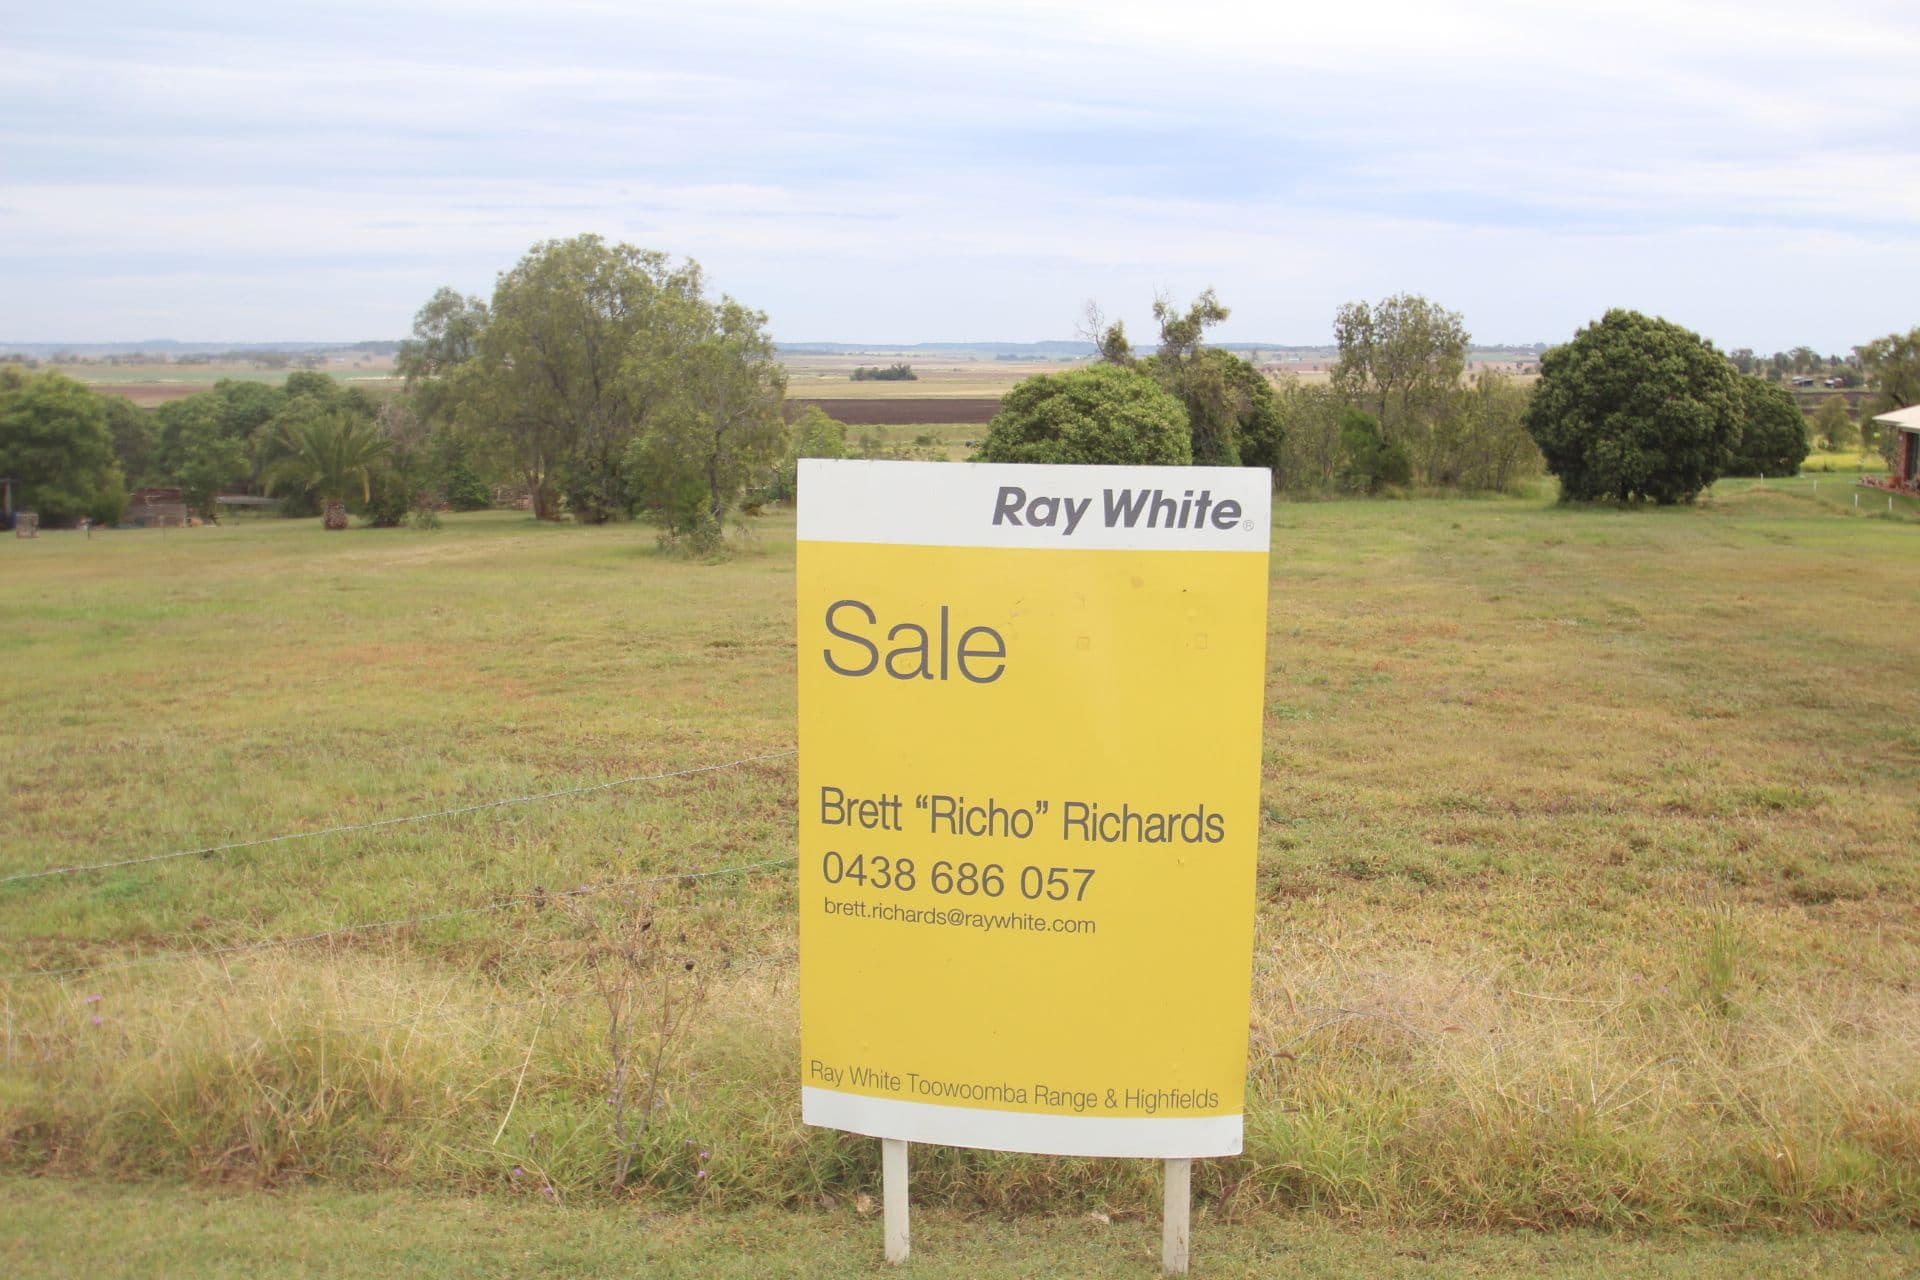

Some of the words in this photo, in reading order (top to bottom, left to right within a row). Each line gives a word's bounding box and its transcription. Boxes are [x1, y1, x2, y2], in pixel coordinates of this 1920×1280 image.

[992, 486, 1092, 536] Ray
[823, 599, 1007, 684] Sale
[821, 786, 903, 831] Brett
[1063, 801, 1225, 844] Richards
[823, 851, 916, 892] 0438
[931, 860, 1005, 898] 686
[1020, 865, 1096, 902] 057
[824, 897, 1096, 934] brett.richards@raywhite.com
[811, 1060, 844, 1088] Ray
[850, 1065, 901, 1092] White
[907, 1072, 1028, 1104] Toowoomba
[1034, 1085, 1098, 1113] Range
[1104, 1088, 1118, 1109] &
[1125, 1088, 1219, 1114] Highfields
